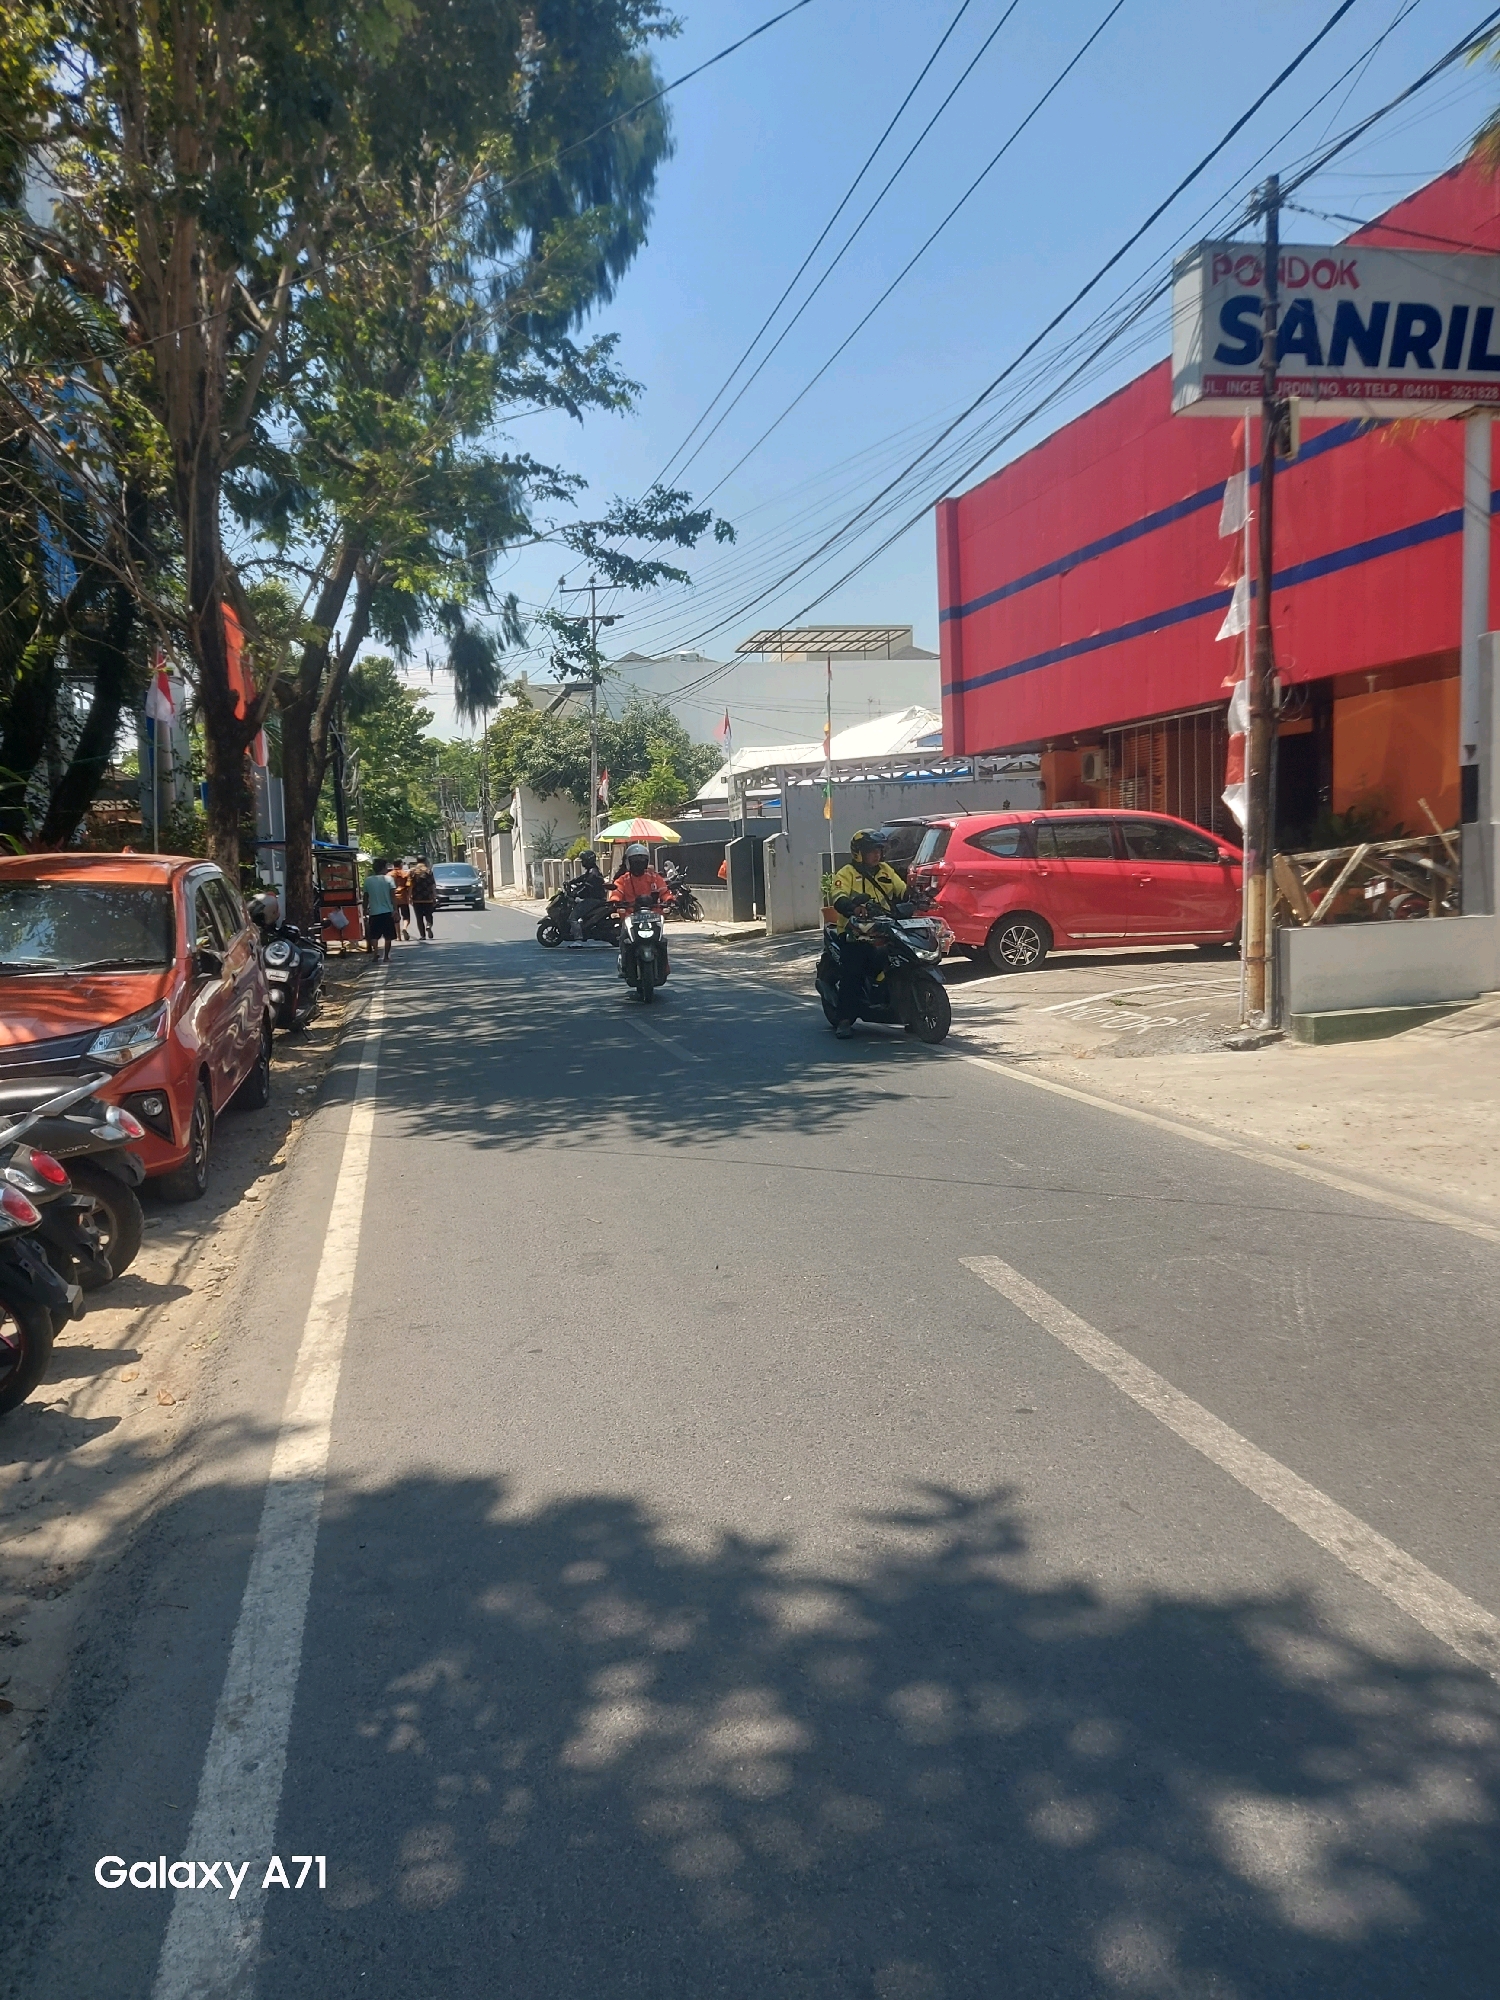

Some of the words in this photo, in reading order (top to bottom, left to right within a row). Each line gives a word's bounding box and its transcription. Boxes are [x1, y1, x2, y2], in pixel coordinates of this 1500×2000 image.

[1213, 294, 1500, 371] SANRIL
[1205, 380, 1223, 394] JL.
[1226, 380, 1260, 395] INCE
[1345, 382, 1362, 396] 12
[1402, 383, 1440, 400] (0411)
